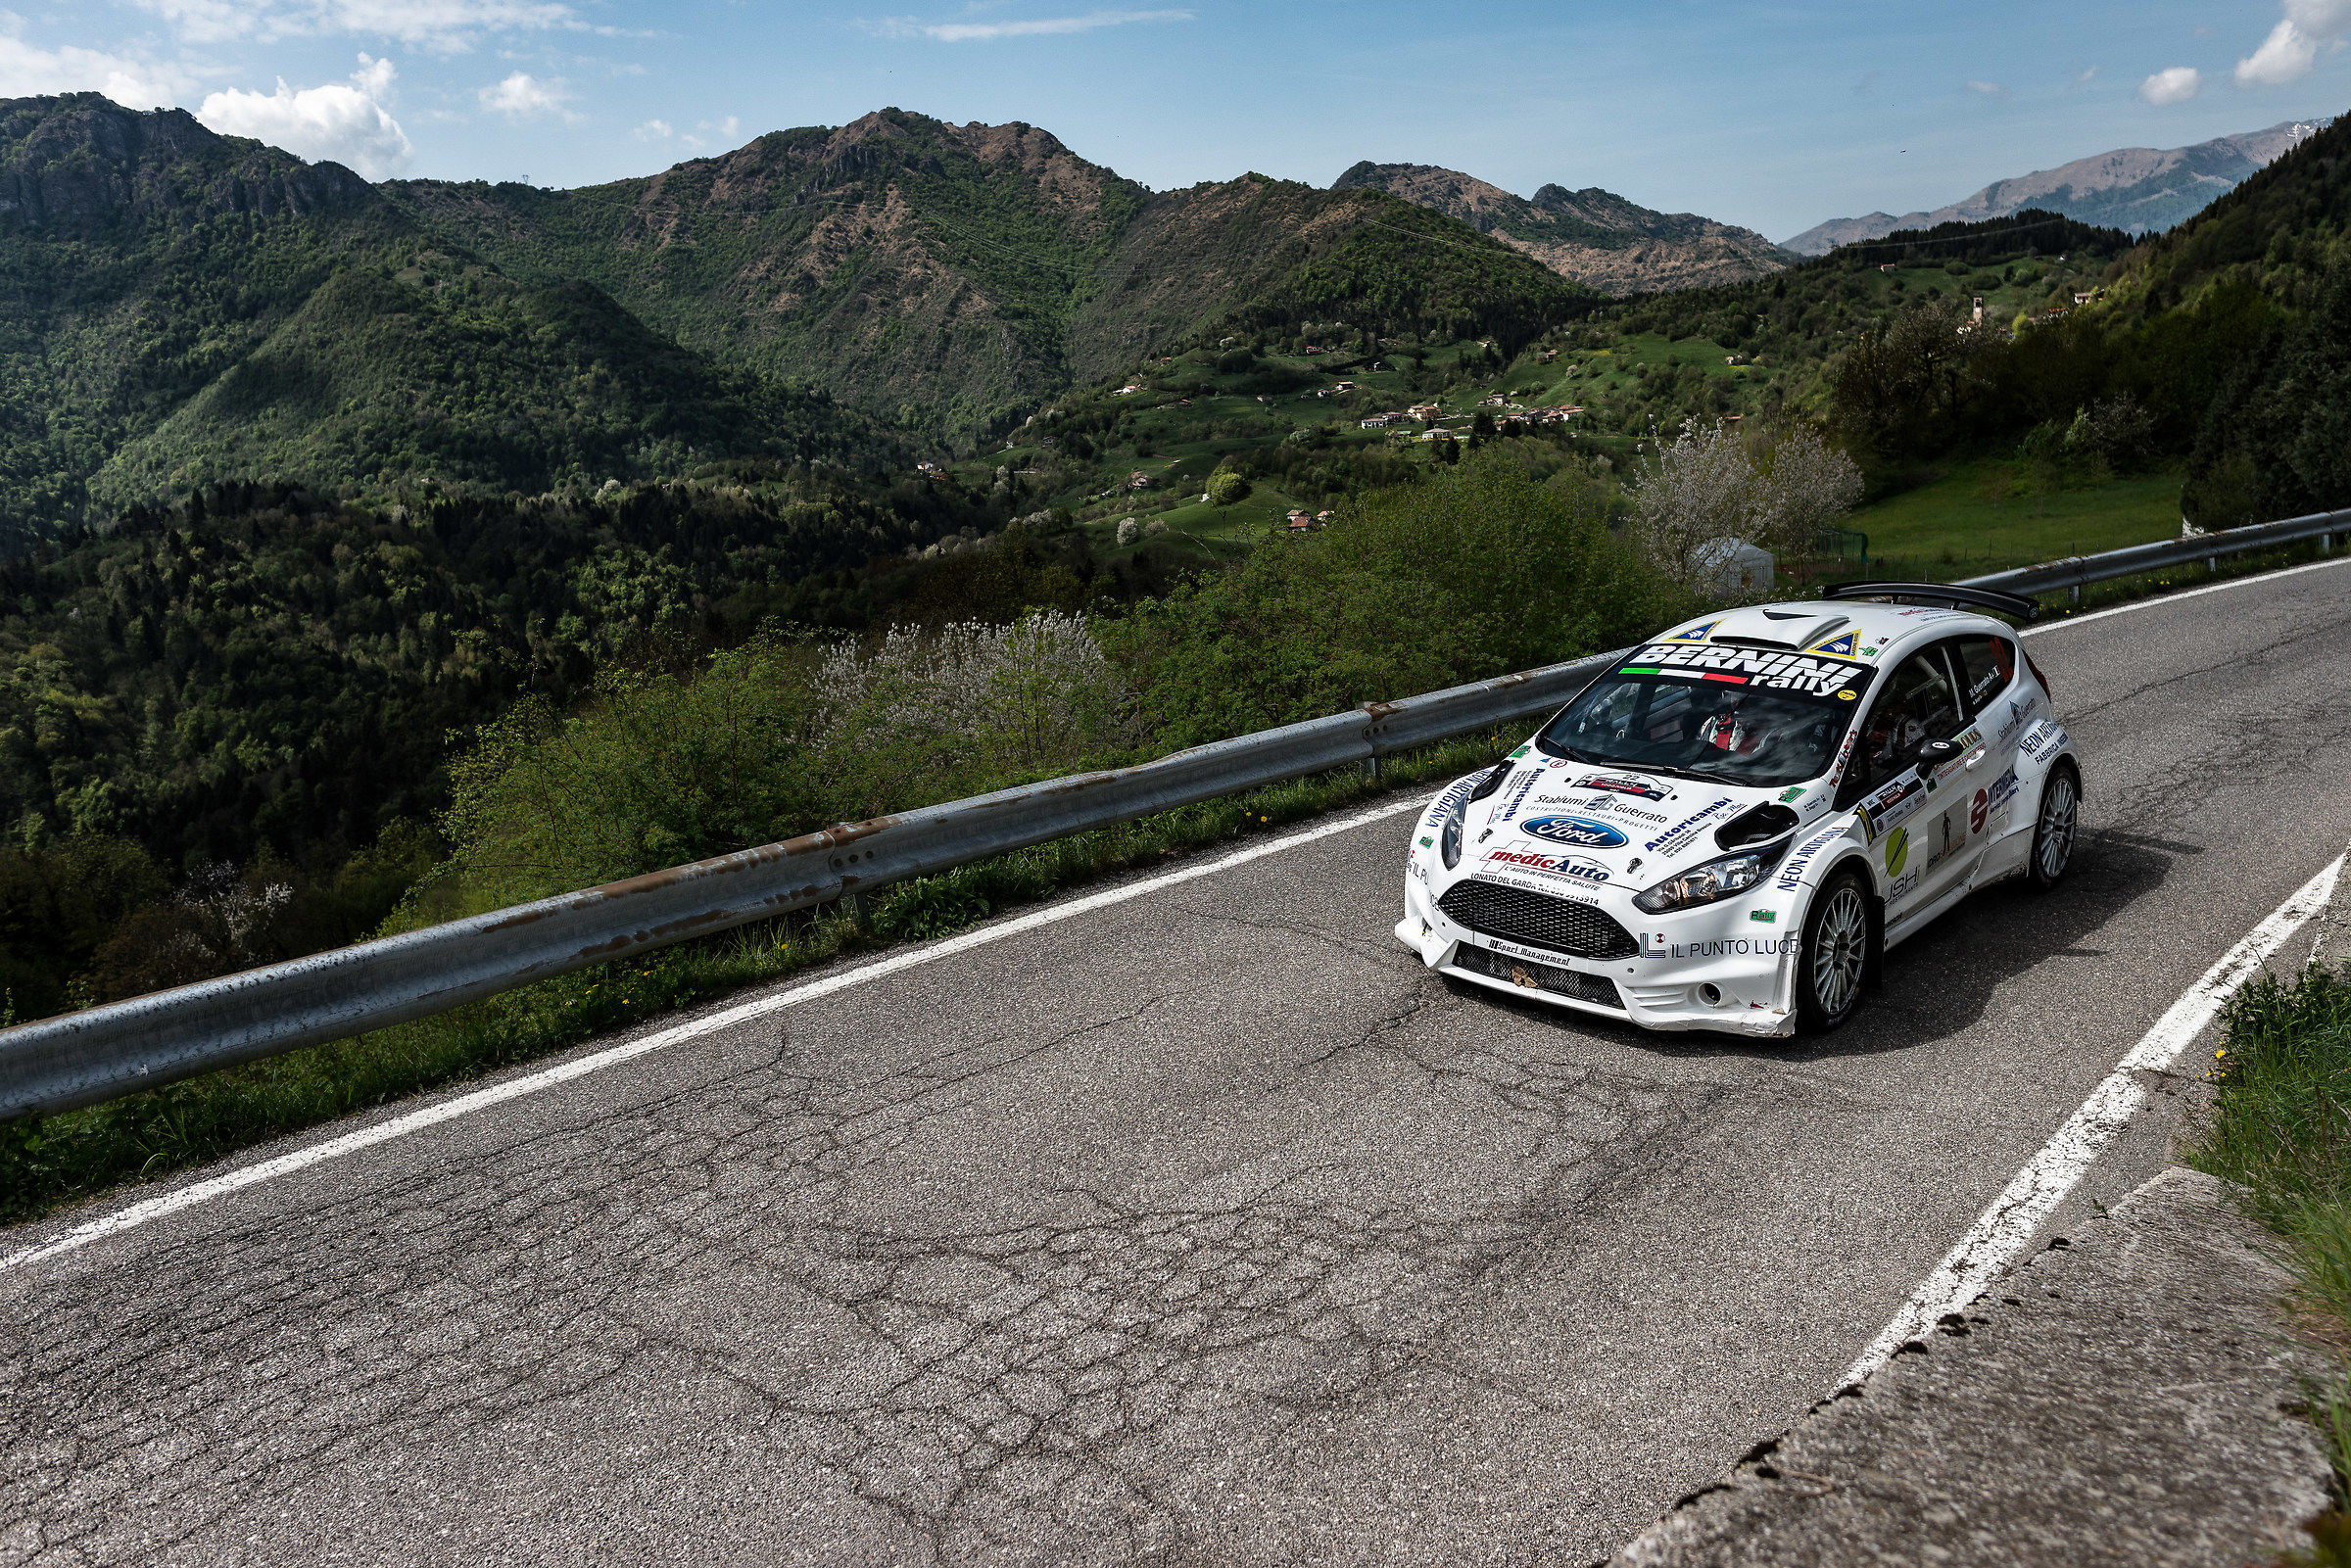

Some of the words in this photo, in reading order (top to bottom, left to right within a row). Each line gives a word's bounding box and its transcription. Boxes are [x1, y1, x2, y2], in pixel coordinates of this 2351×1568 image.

[1629, 644, 1862, 684] BERNINI
[1750, 674, 1845, 696] rally
[2019, 728, 2041, 757] NEON
[1503, 768, 1546, 822] Autoricambi
[1534, 794, 1589, 806] Stabiumi
[1614, 803, 1668, 824] Guerrato
[1536, 819, 1608, 844] Ford
[1645, 797, 1733, 852] Autoricambi
[1489, 850, 1609, 882] medicAuto
[1777, 859, 1807, 891] NEON
[1800, 827, 1850, 860] ARTIGIANA
[1470, 873, 1497, 882] LONATO
[1497, 875, 1511, 884] DEL
[1537, 872, 1571, 884] PERFETTA
[1571, 880, 1601, 891] SALUTE
[1671, 944, 1684, 958] IL
[1690, 939, 1750, 957] PUNTO
[1753, 939, 1799, 955] LUCE
